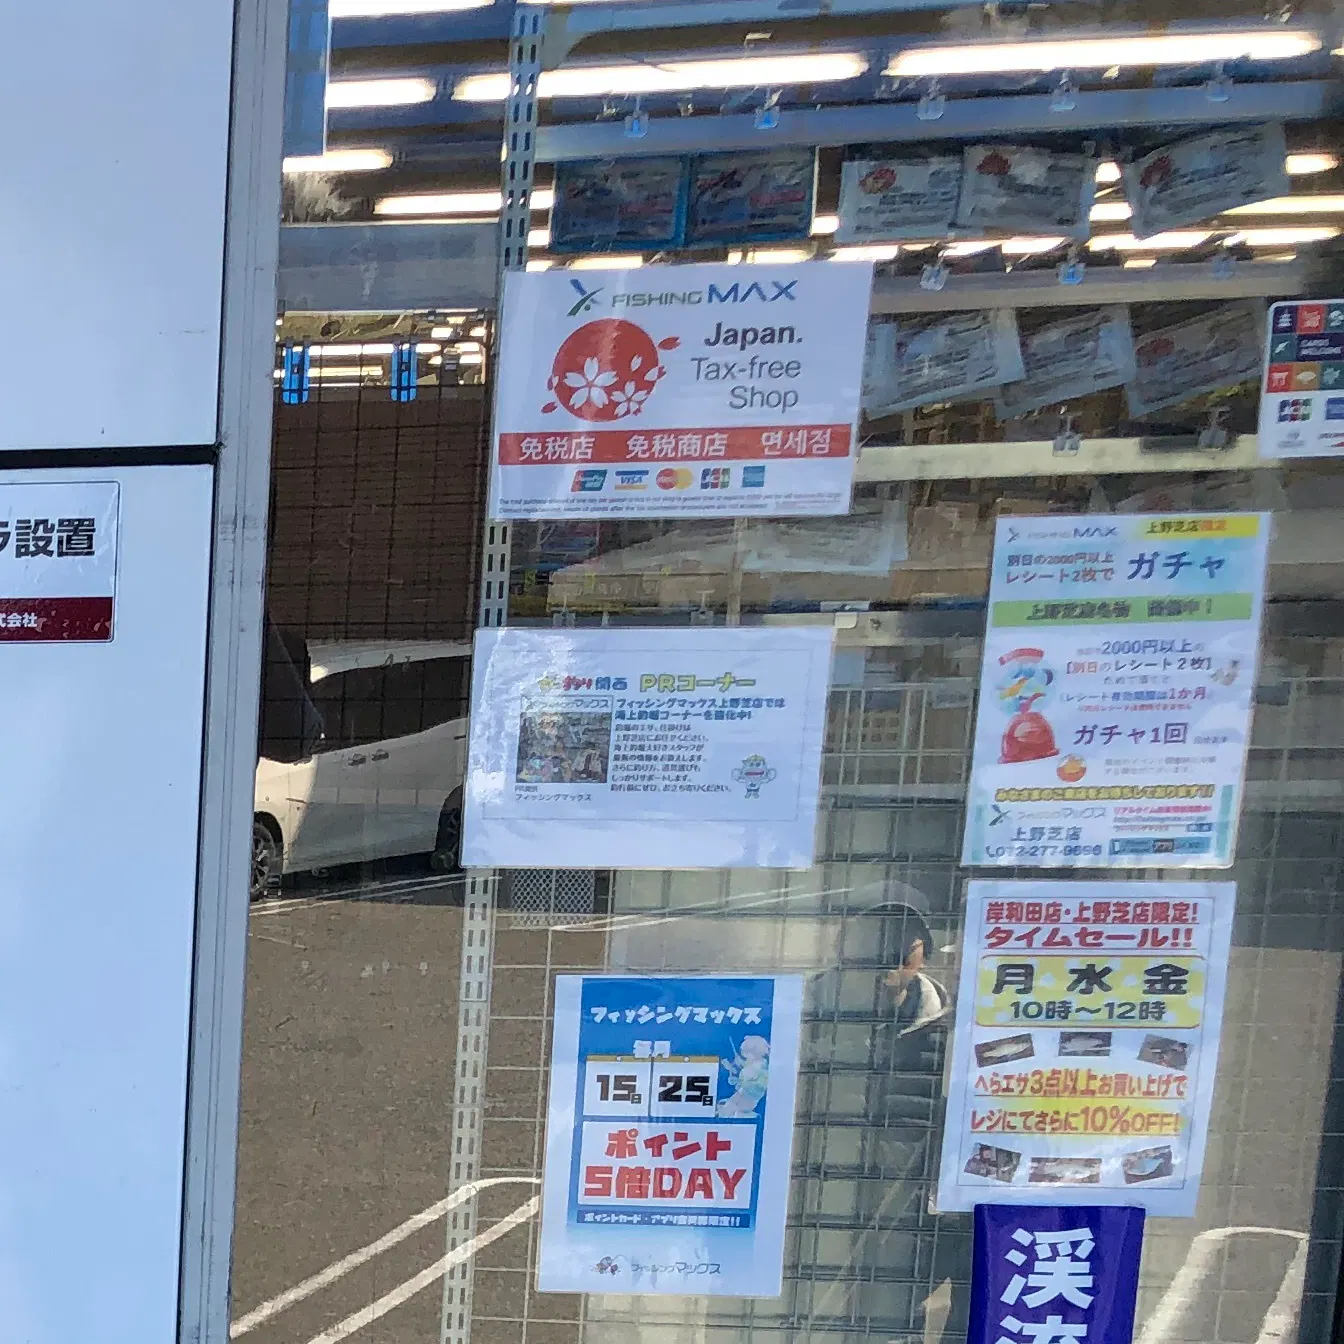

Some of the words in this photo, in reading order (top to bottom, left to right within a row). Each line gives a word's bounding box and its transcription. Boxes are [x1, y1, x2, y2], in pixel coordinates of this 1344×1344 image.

[612, 291, 702, 308] FISHING
[707, 279, 797, 304] MAX
[704, 322, 802, 351] Japan.
[691, 355, 801, 381] Tax-free
[729, 385, 798, 413] Shop
[520, 436, 595, 460] 免税店
[626, 433, 728, 459] 免税商店
[762, 429, 832, 457] 면세점
[620, 476, 643, 484] VISA
[1073, 527, 1119, 538] MAX
[1006, 568, 1115, 584] レシート2枚で
[1127, 551, 1225, 580] ガチャ
[640, 672, 756, 693] PRコーナー
[1073, 722, 1188, 745] ガチャ1回
[1011, 826, 1083, 842] 上野芝店
[992, 963, 1035, 995] 月
[1066, 963, 1113, 995] 水
[1142, 963, 1189, 995] 金
[590, 1004, 762, 1025] フィッシングマックス
[632, 1039, 671, 1059] 毎月
[596, 1075, 642, 1105] 15日
[658, 1075, 714, 1106] 25日
[974, 1068, 1188, 1096] へらエサ3点以上お買い上げで
[605, 1128, 731, 1161] ポイント
[584, 1166, 747, 1200] 5倍DAY
